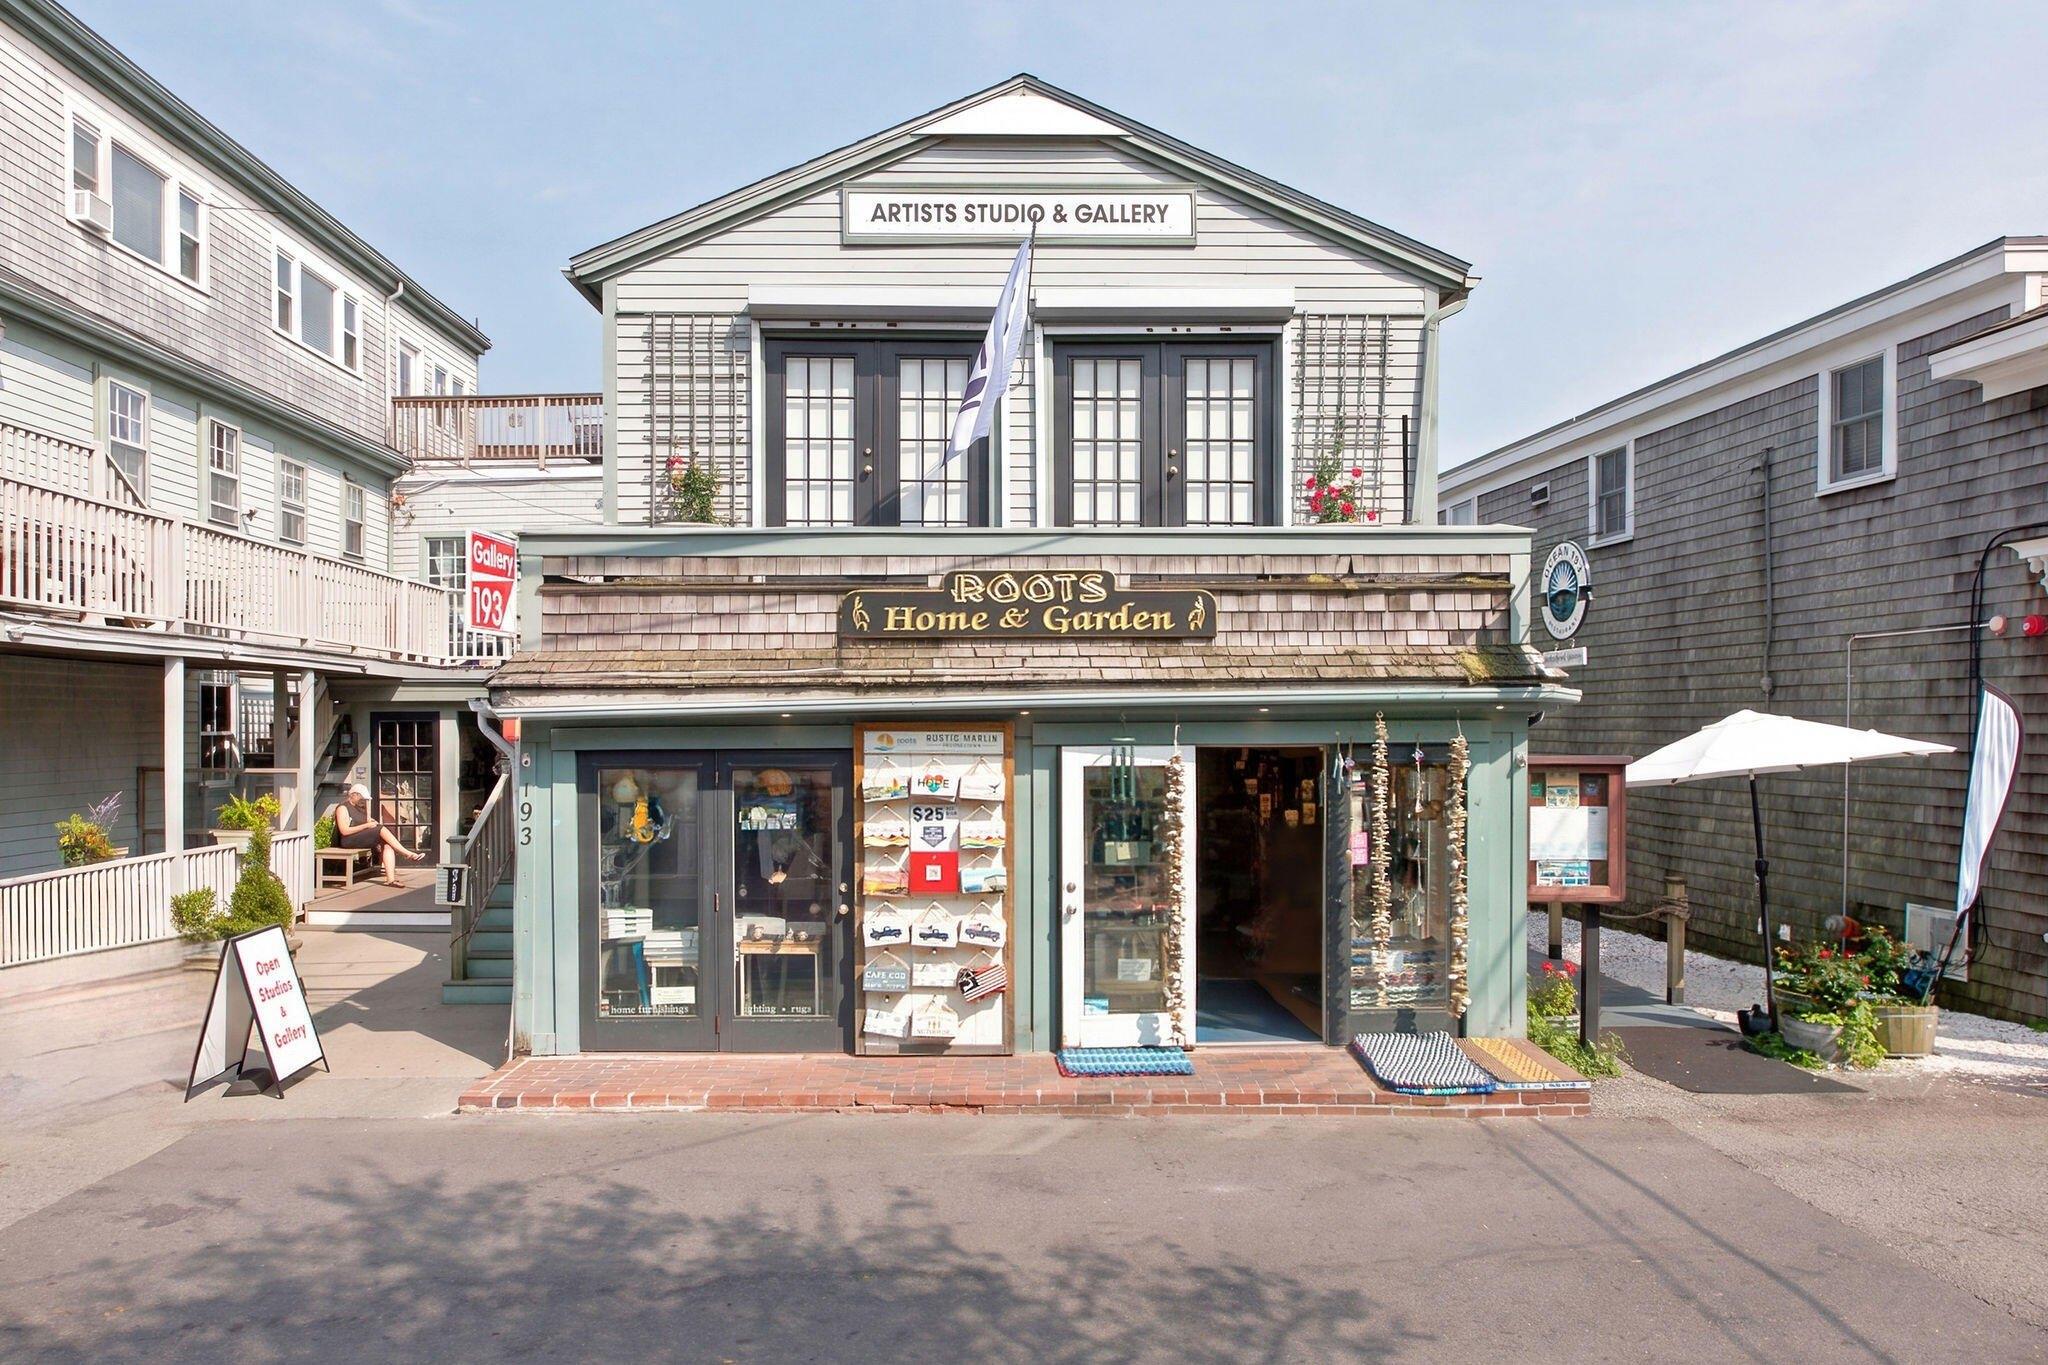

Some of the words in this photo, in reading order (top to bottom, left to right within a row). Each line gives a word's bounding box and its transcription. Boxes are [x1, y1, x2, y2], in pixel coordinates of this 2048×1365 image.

[870, 202, 957, 224] ARTISTS
[964, 202, 1045, 224] STUDIO
[1053, 203, 1068, 224] &
[1074, 203, 1170, 224] GALLERY
[473, 540, 514, 577] Gallery
[1544, 546, 1569, 578] OCEAN
[951, 573, 1108, 603] ROOTS
[473, 586, 503, 626] 193
[883, 606, 990, 632] Home
[999, 606, 1030, 629] &
[1042, 601, 1176, 633] Garden
[926, 734, 960, 743] RUSTIC
[963, 734, 998, 743] MARLIN
[917, 778, 950, 789] HOPE
[520, 783, 533, 846] 193
[912, 806, 944, 822] $25
[256, 957, 280, 976] Open
[258, 979, 293, 1003] Studios
[280, 1006, 287, 1018] &
[611, 1004, 636, 1014] home
[638, 1004, 689, 1015] furnishings
[791, 1006, 812, 1014] rugs
[274, 1023, 307, 1049] Gallery
